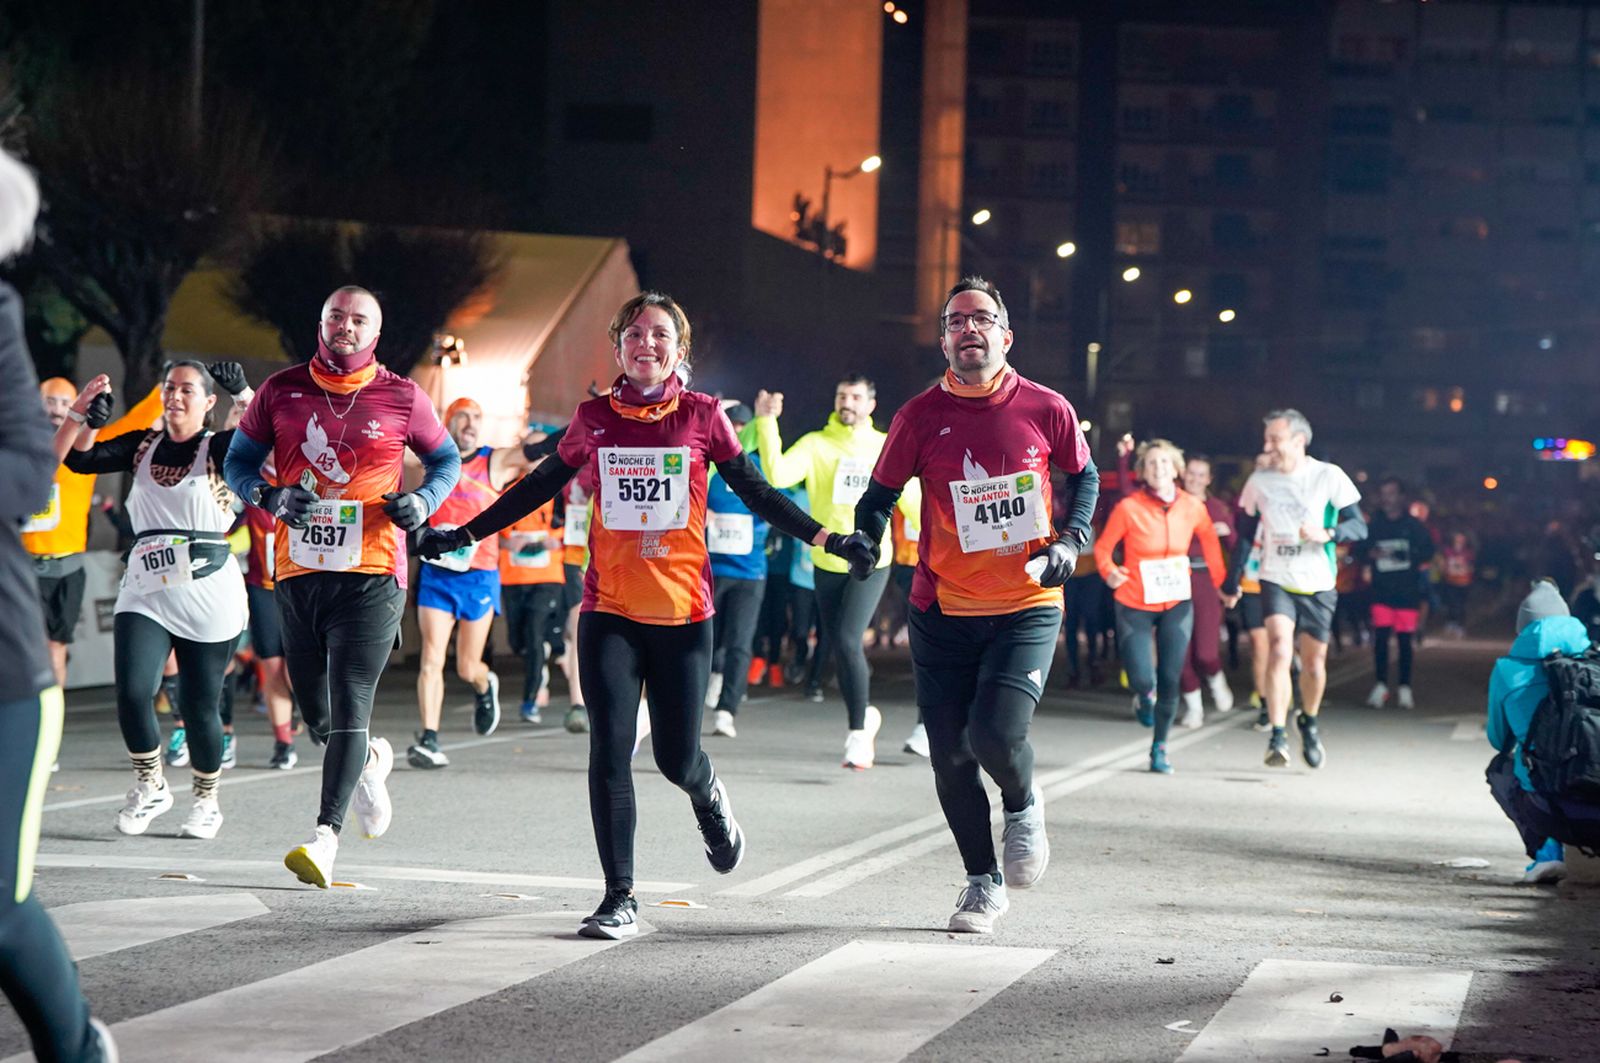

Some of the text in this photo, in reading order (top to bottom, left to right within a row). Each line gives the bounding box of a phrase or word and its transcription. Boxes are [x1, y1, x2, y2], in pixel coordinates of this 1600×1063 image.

[316, 452, 336, 472] 43
[618, 457, 643, 466] NOCHE
[645, 457, 656, 466] DE
[608, 467, 626, 476] SAN
[627, 466, 656, 476] ANTÓN
[618, 478, 671, 502] 5521
[971, 485, 997, 495] NOCHE
[998, 483, 1009, 491] DE
[963, 496, 980, 504] SAN
[324, 507, 333, 515] DE
[974, 496, 1026, 524] 4140
[301, 525, 347, 547] 2637
[141, 547, 176, 571] 1670
